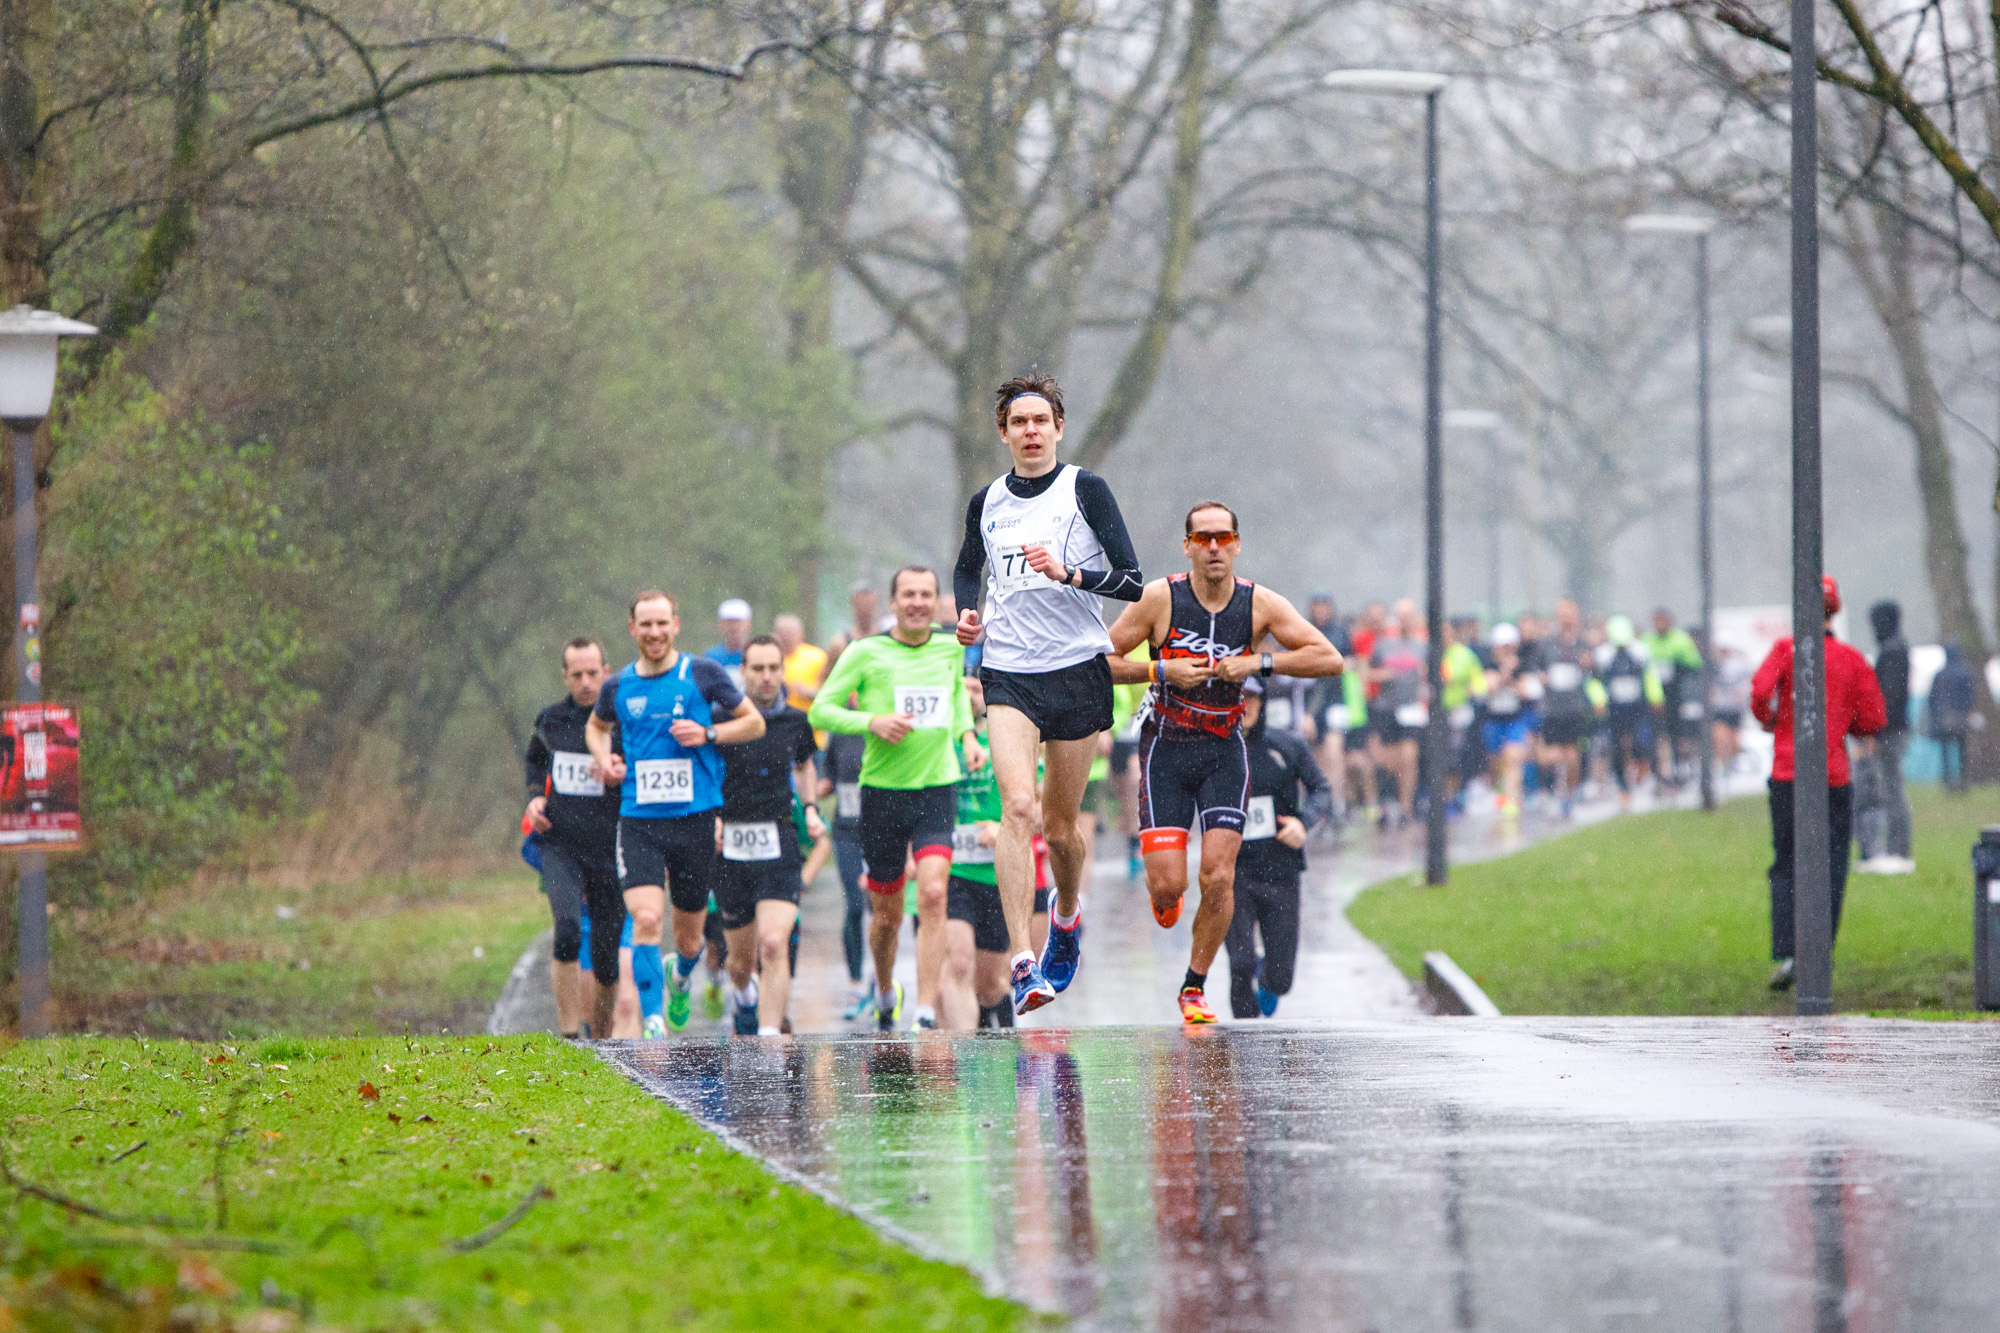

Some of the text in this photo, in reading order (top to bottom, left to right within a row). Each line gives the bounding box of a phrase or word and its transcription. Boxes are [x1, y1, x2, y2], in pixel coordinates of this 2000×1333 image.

[1003, 553, 1026, 576] 77
[904, 696, 940, 714] 837
[558, 763, 593, 782] 115
[640, 770, 689, 790] 1236
[732, 828, 769, 848] 903
